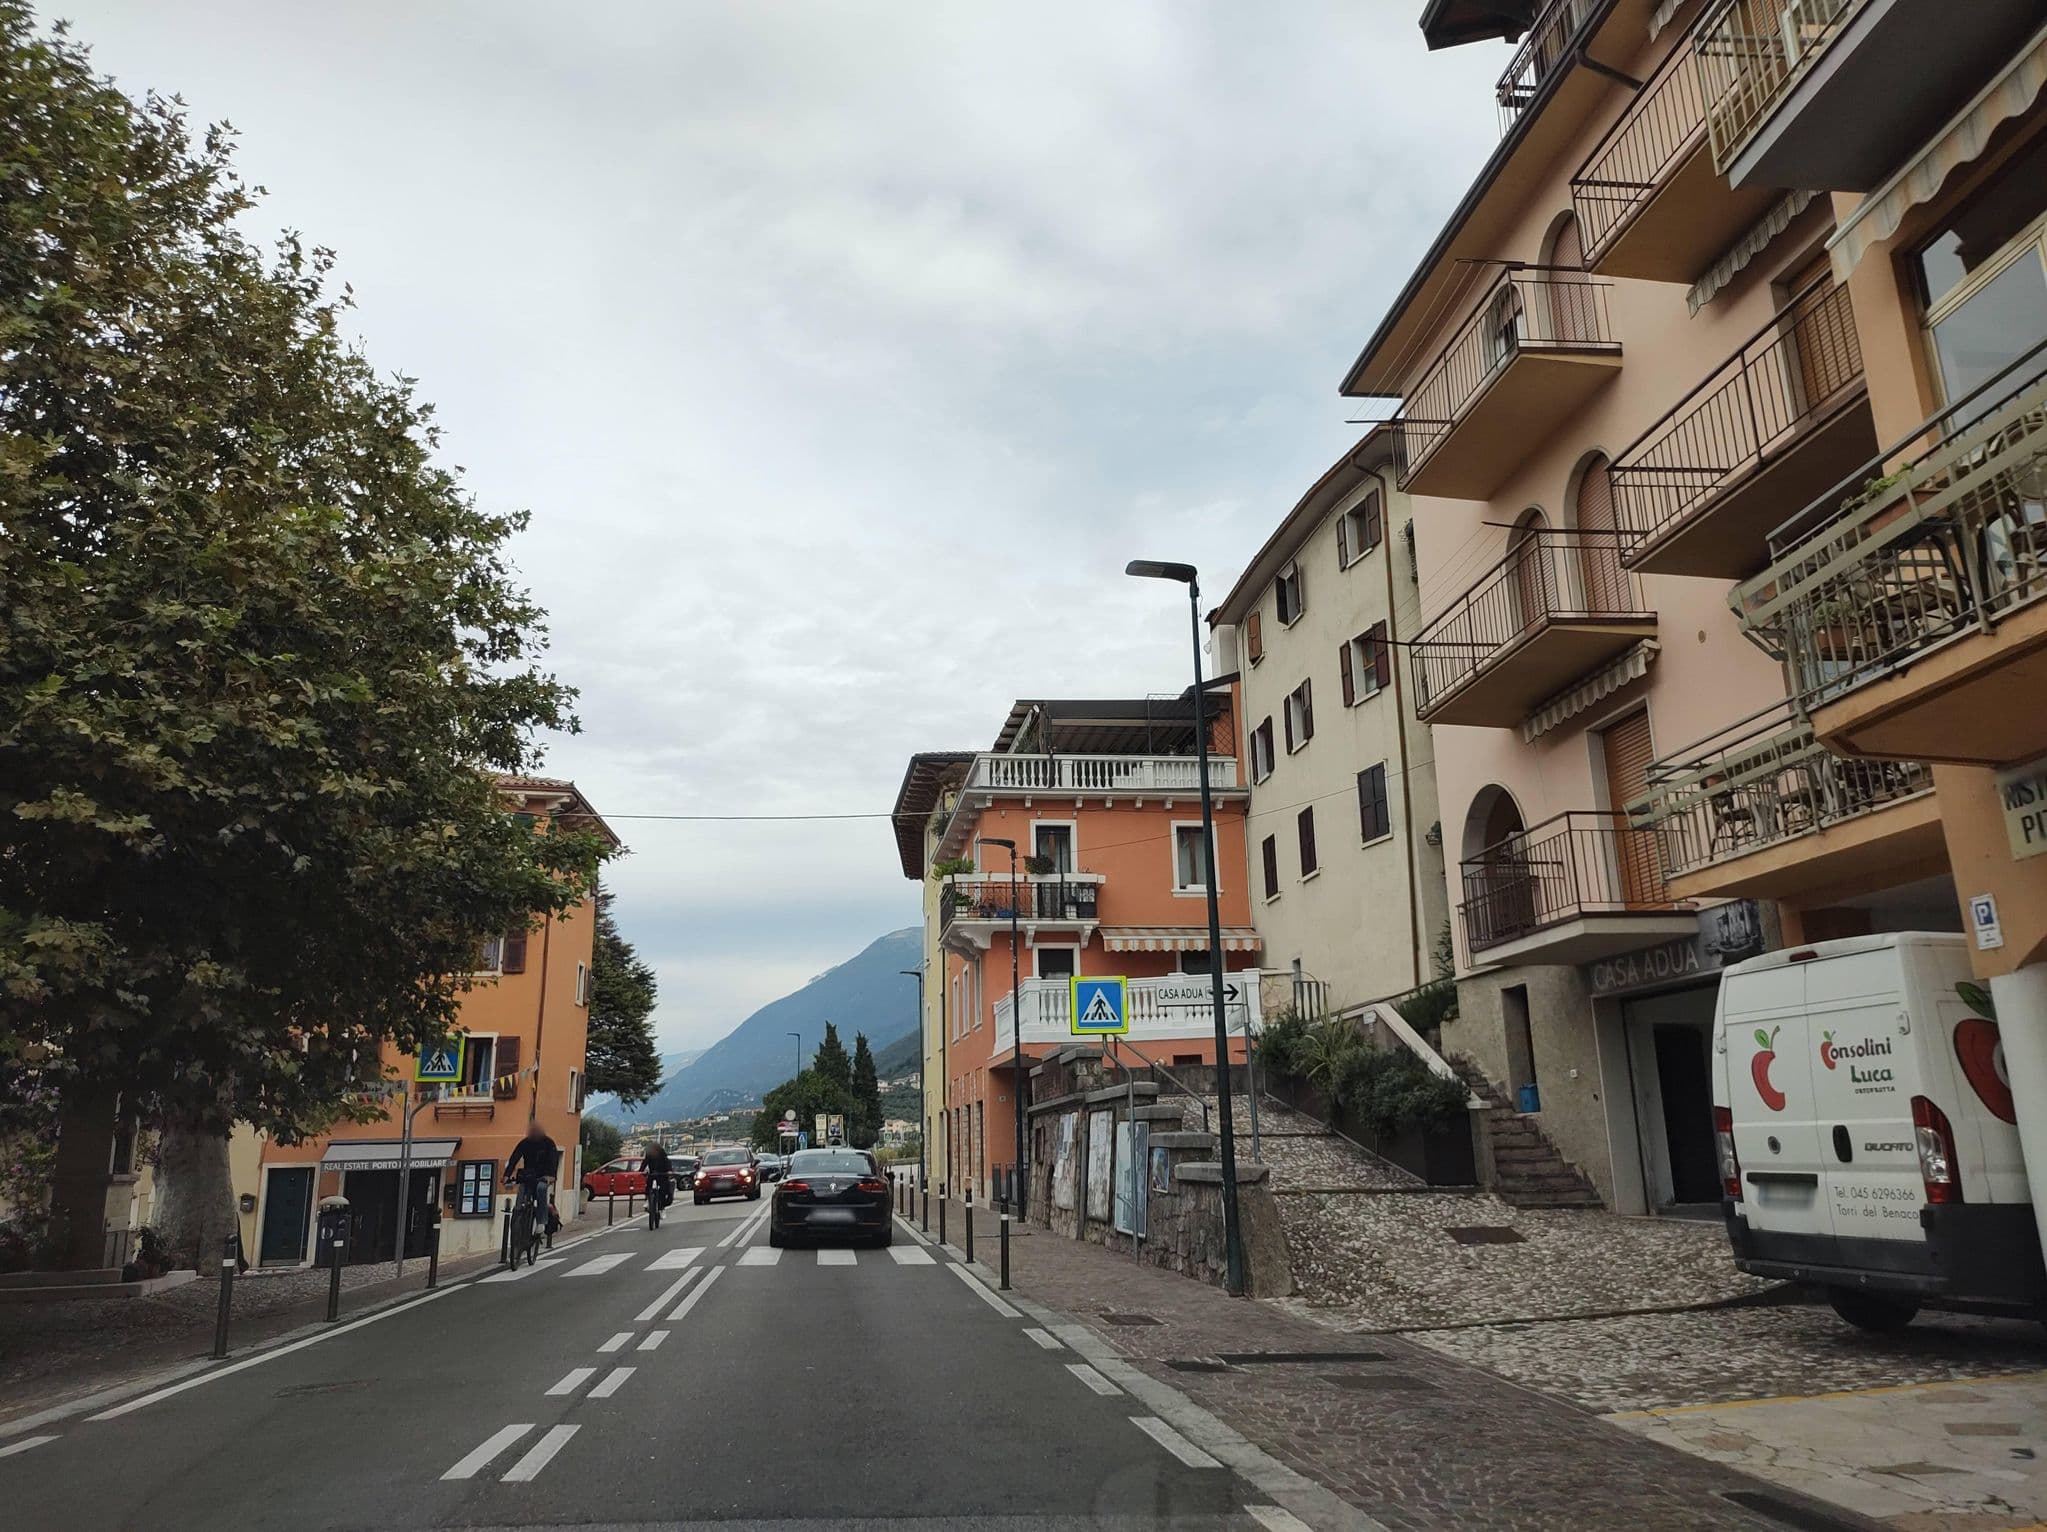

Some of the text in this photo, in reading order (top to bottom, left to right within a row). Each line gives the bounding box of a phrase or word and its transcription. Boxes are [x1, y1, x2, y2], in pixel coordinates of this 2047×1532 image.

[1594, 942, 1699, 990] CASA ADUA
[1158, 988, 1204, 1000] CASA ADUA
[1850, 1065, 1894, 1083] Luca
[1864, 1142, 1914, 1152] DUCATO
[324, 1162, 341, 1171] REAL
[343, 1161, 369, 1171] ESTATE
[372, 1160, 398, 1170] PORTO
[1850, 1186, 1869, 1199] 045
[1872, 1187, 1915, 1201] 6296366
[1836, 1203, 1920, 1220] Torri del Benaco
